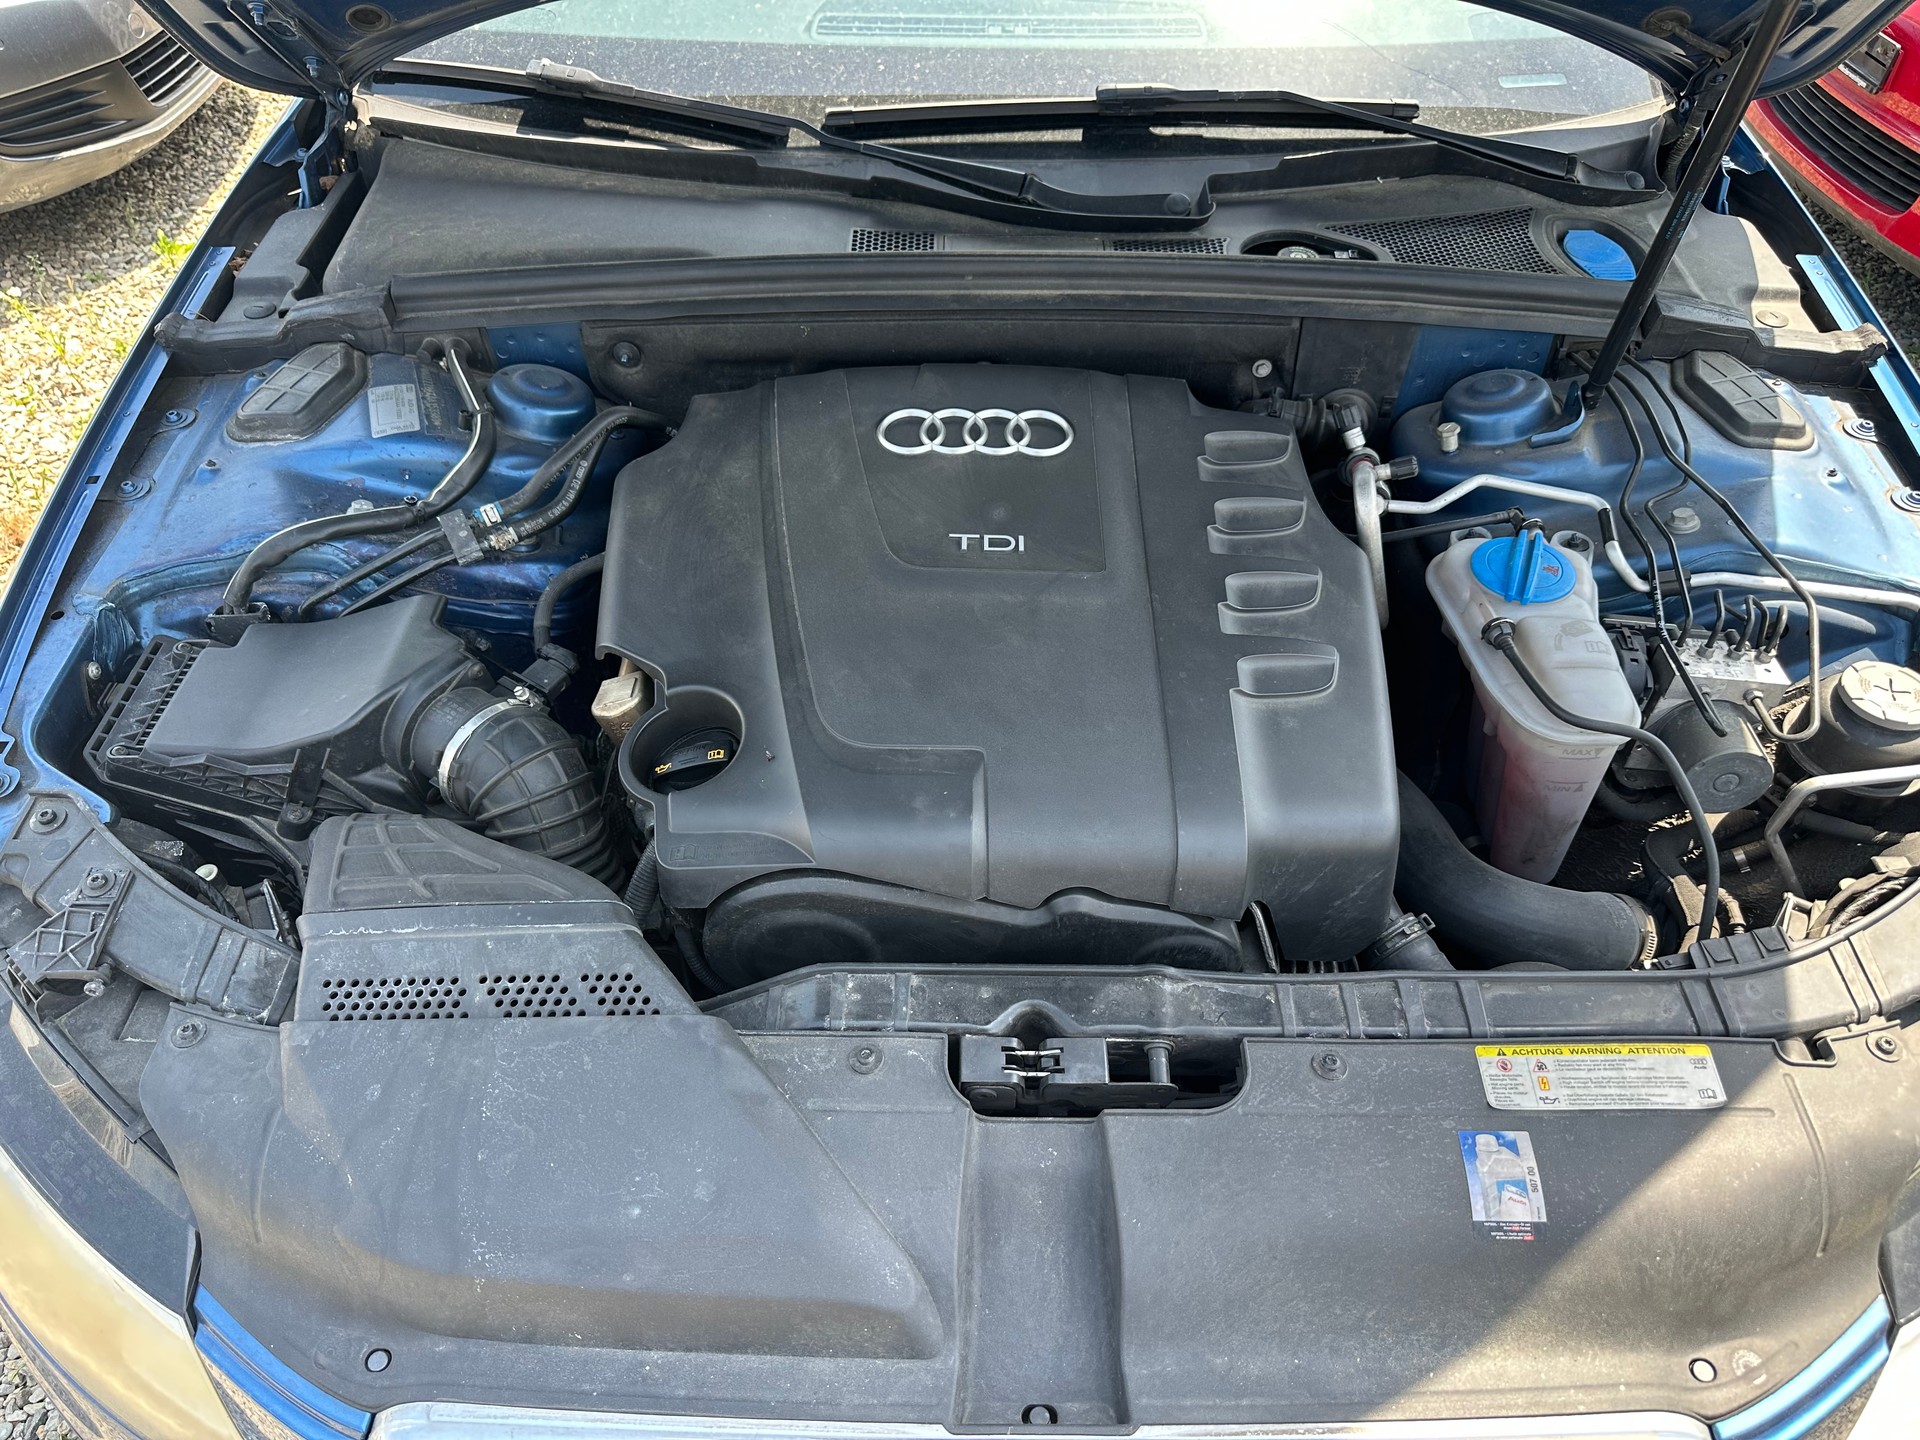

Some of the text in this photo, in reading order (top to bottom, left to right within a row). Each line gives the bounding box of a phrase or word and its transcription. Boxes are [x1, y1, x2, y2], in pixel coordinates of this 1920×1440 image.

[948, 533, 1025, 552] TDI
[1561, 748, 1593, 756] MAX
[1543, 784, 1572, 792] MIN
[1511, 1047, 1686, 1055] ACHTUNG WARNING ATTENTION
[1527, 1166, 1539, 1193] 507 00
